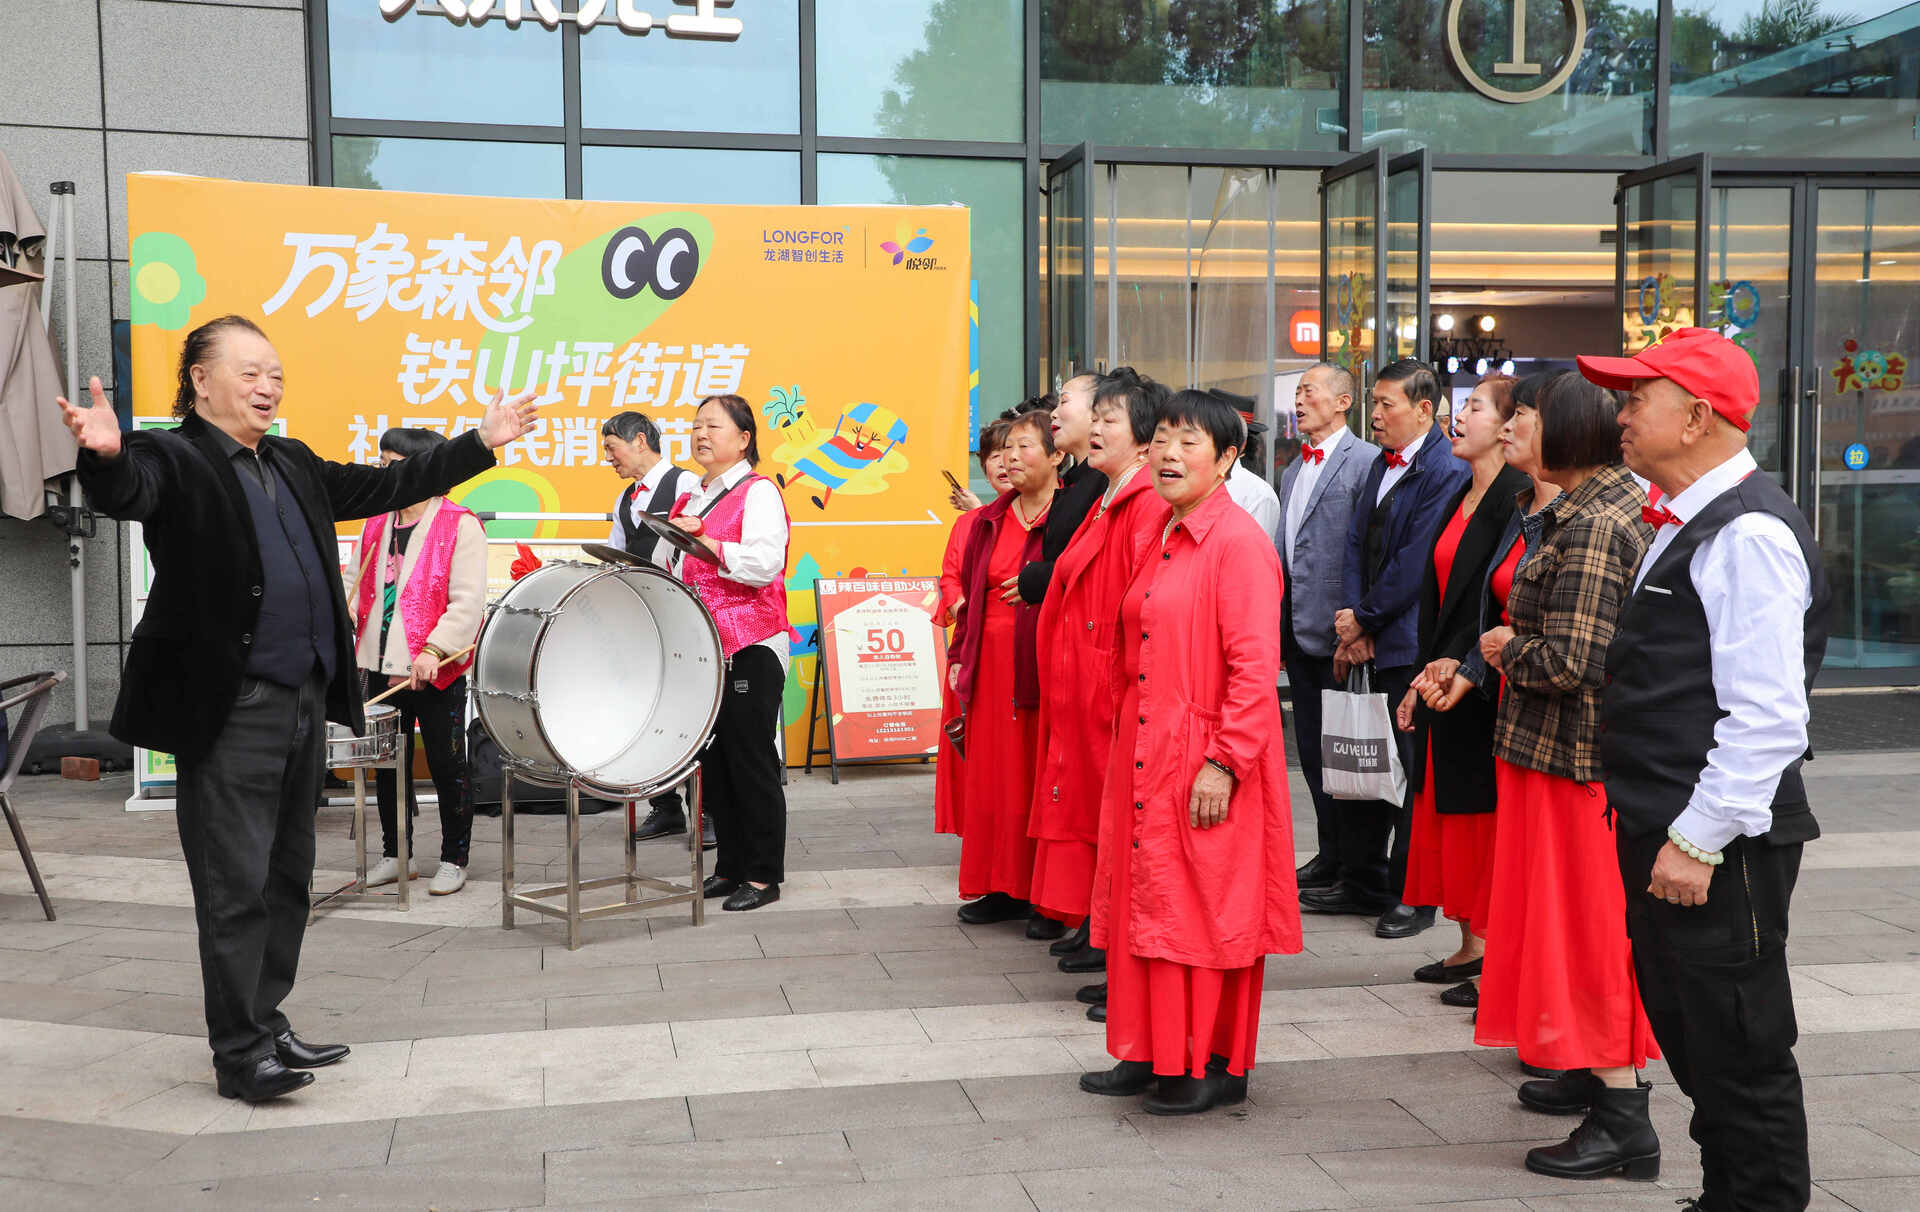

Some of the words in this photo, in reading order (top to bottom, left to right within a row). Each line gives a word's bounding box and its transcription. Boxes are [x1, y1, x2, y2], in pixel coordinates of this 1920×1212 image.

[763, 230, 844, 245] LONGFOR
[764, 248, 844, 264] 龙湖智创生活
[262, 222, 563, 333] 万象森邻
[397, 332, 750, 409] 铁山坪街道
[1849, 449, 1865, 465] 拉
[867, 629, 905, 653] 50
